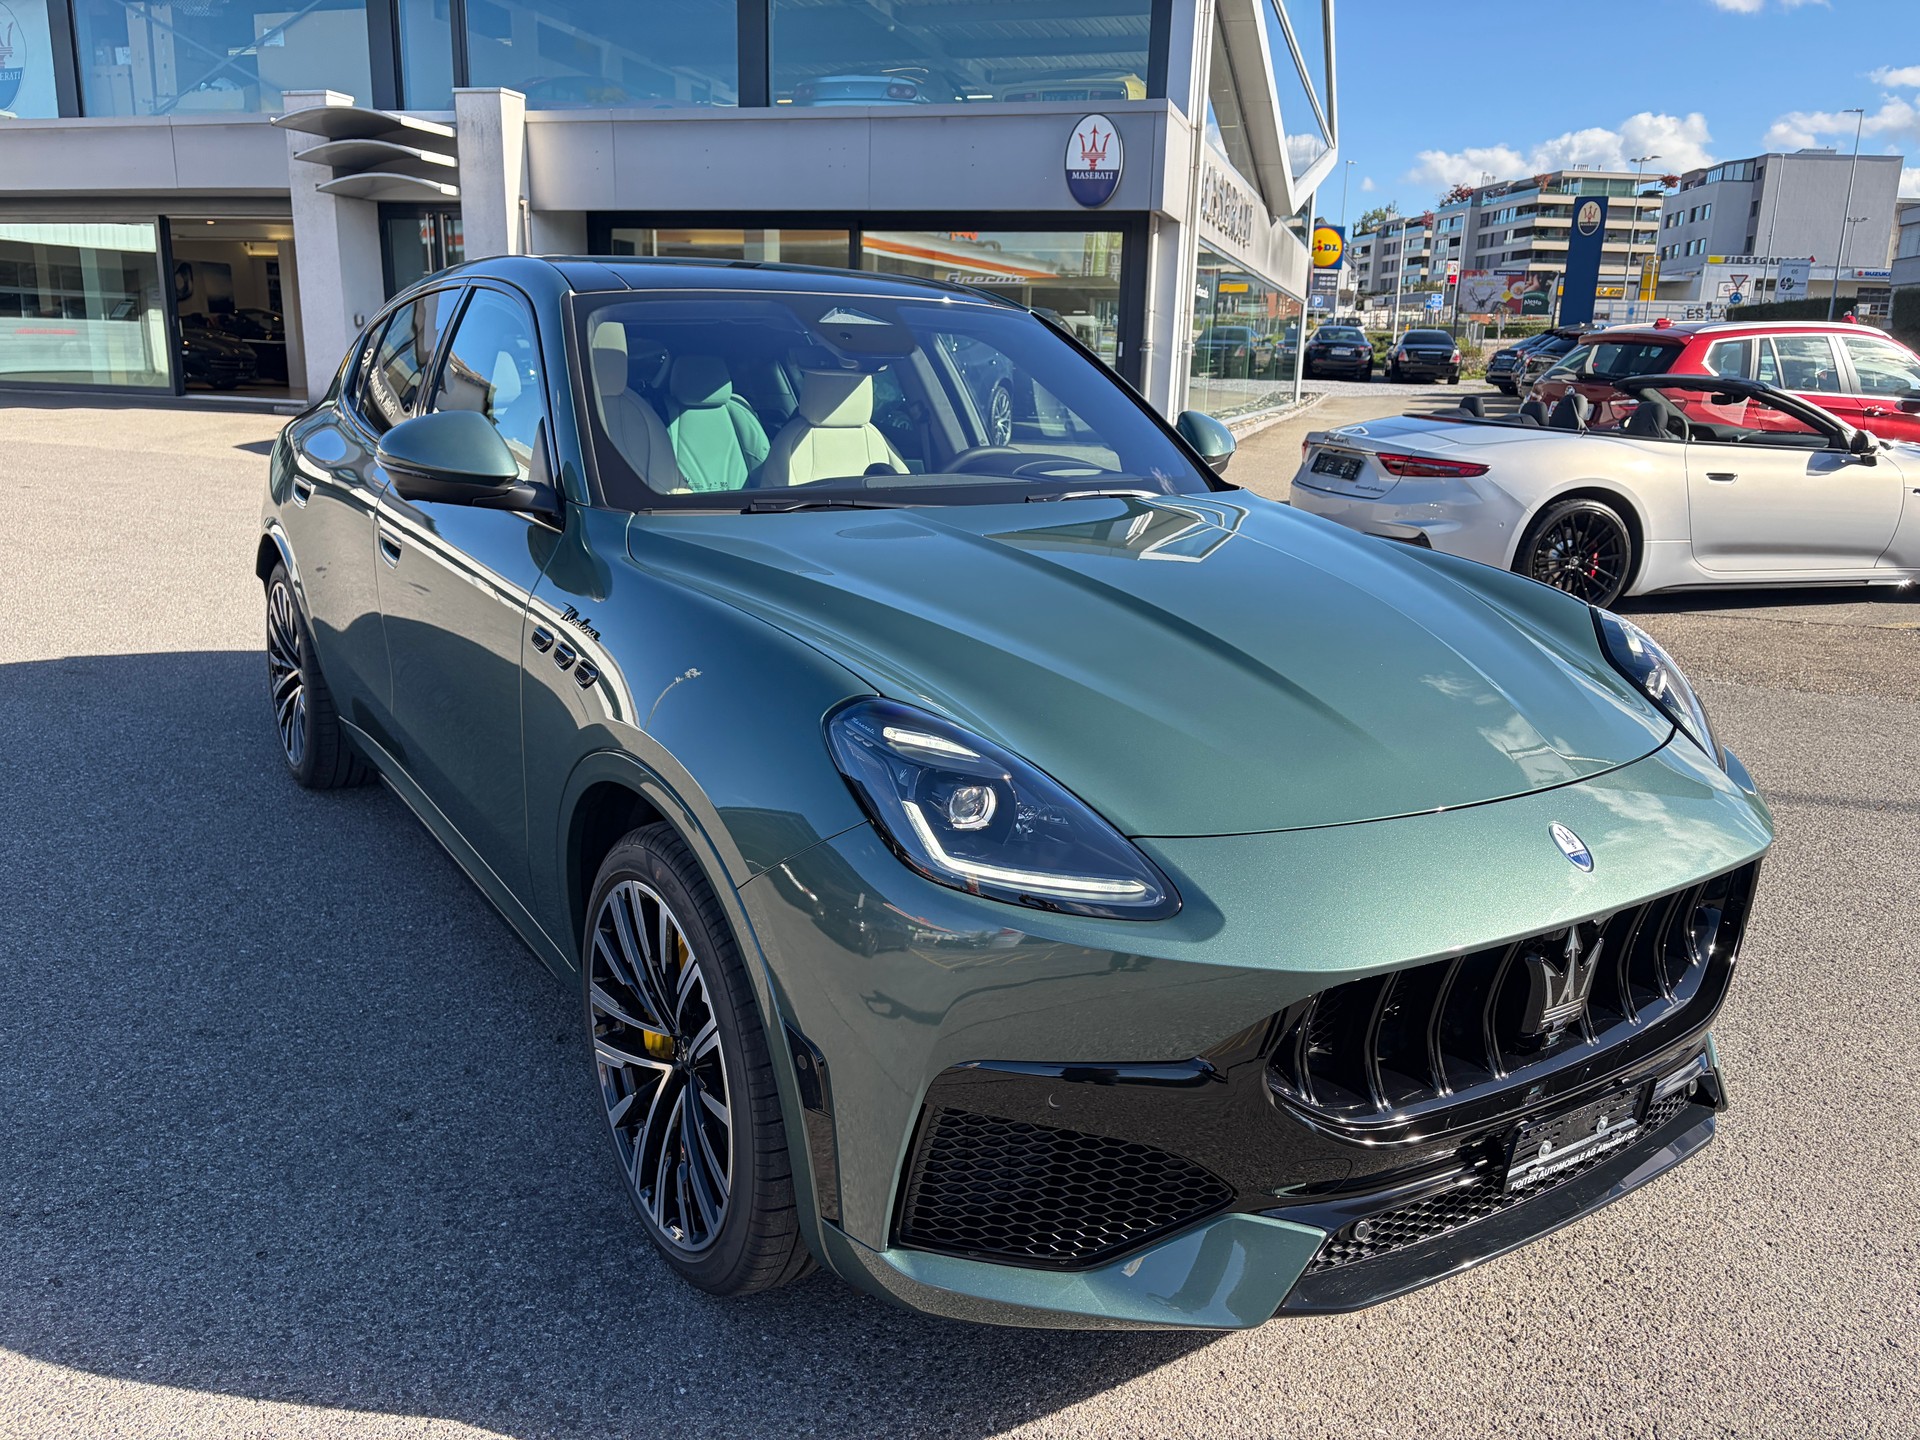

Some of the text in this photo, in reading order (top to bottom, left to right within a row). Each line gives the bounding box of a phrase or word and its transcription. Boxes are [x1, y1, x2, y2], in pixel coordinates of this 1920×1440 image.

[1072, 171, 1113, 180] MASERATI
[1724, 256, 1808, 265] FIRSTGA
[945, 272, 1029, 285] Grecale
[561, 602, 601, 642] Modena
[1510, 1172, 1539, 1191] FOITEK
[1538, 1152, 1586, 1180] AUTOMOBILE
[1584, 1147, 1598, 1160] AG
